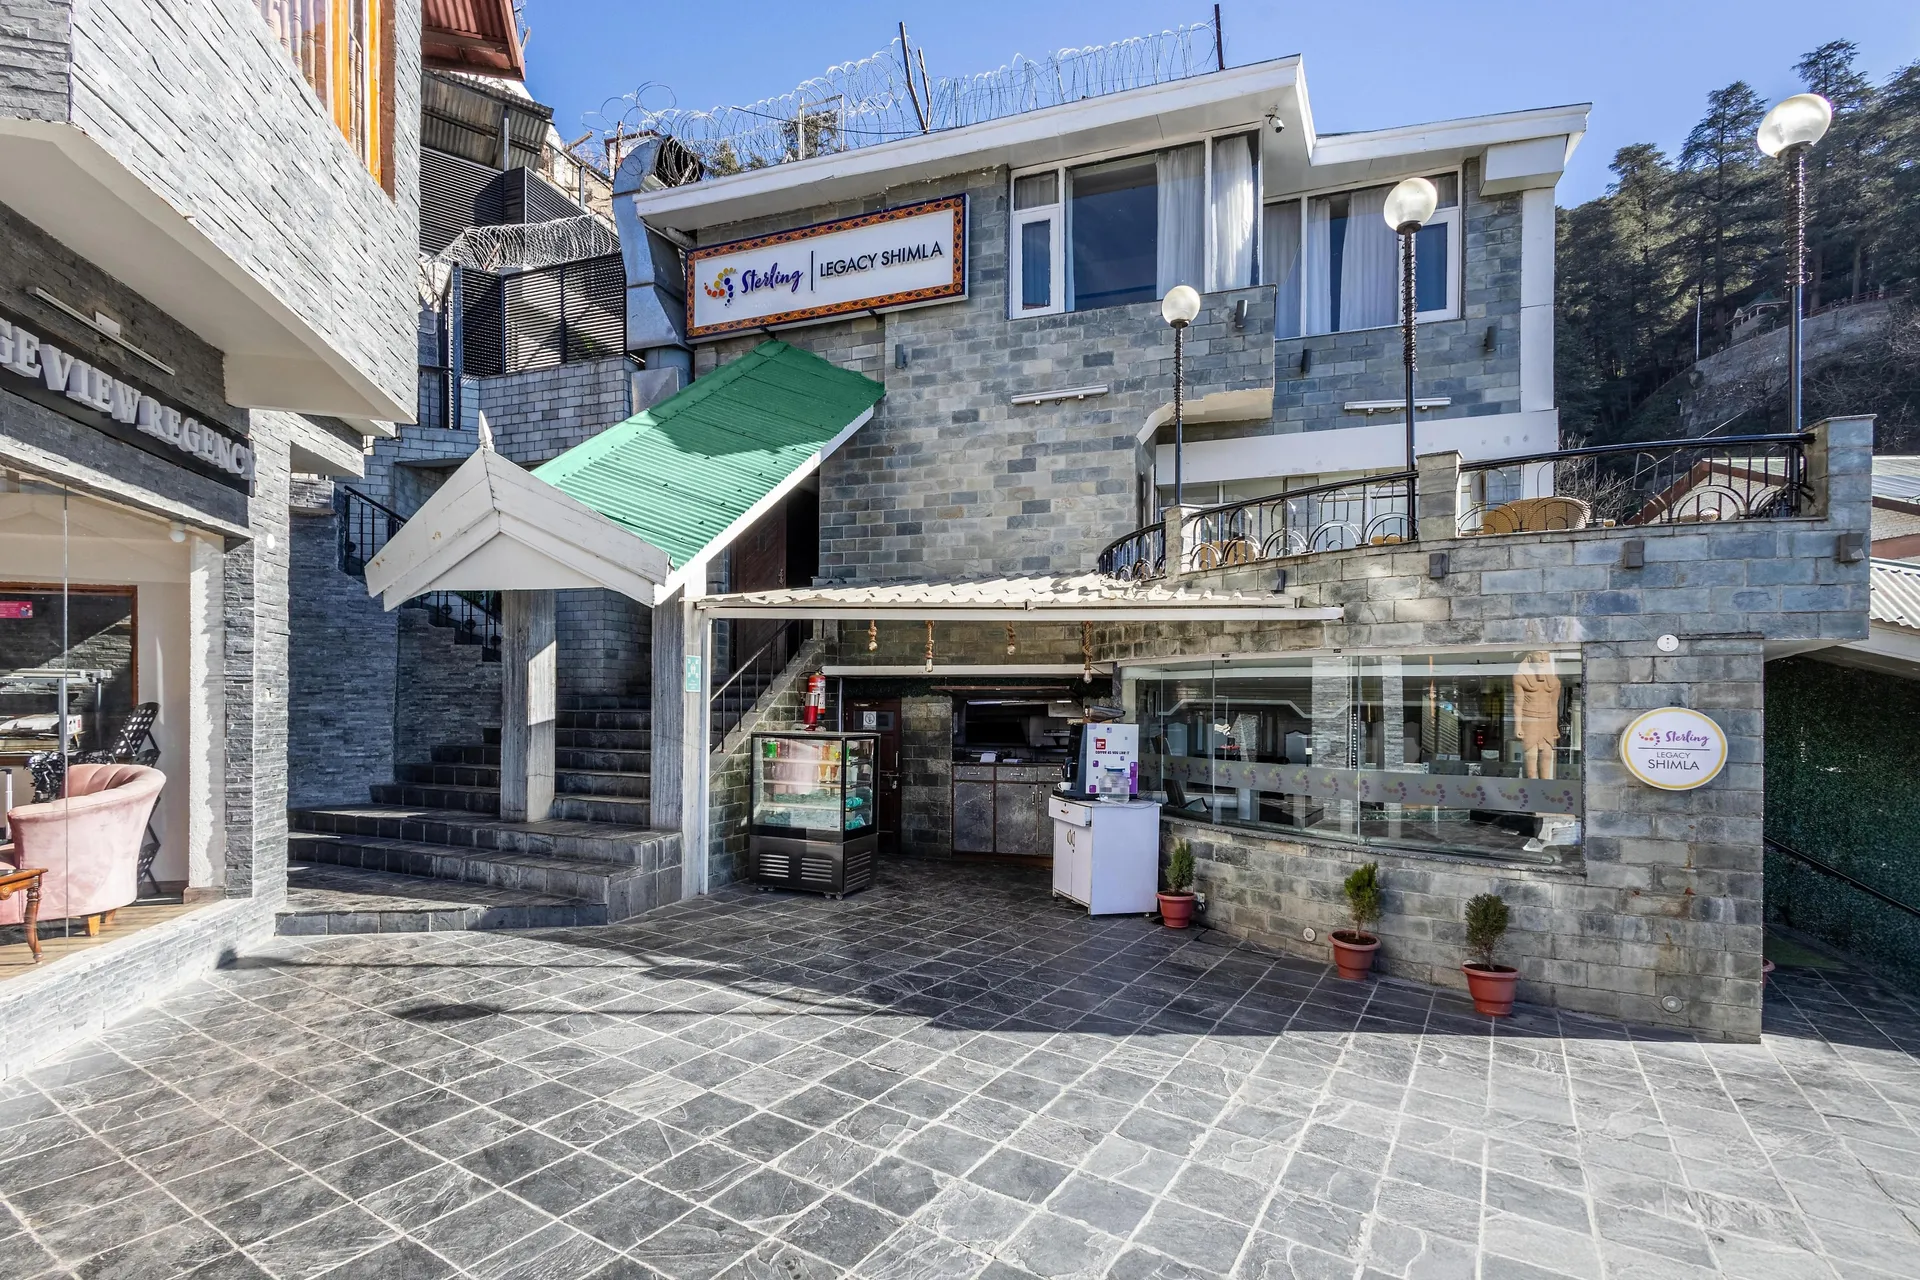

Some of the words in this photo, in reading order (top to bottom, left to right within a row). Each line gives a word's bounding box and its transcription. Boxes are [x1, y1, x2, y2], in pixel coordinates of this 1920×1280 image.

[741, 262, 803, 293] Sterling
[820, 253, 877, 277] LEGACY
[881, 241, 942, 265] SHIMLA
[39, 343, 141, 424] VIEW
[137, 396, 257, 483] REGENCY
[1665, 730, 1710, 747] Sterling
[1648, 759, 1699, 770] SHIMLA
